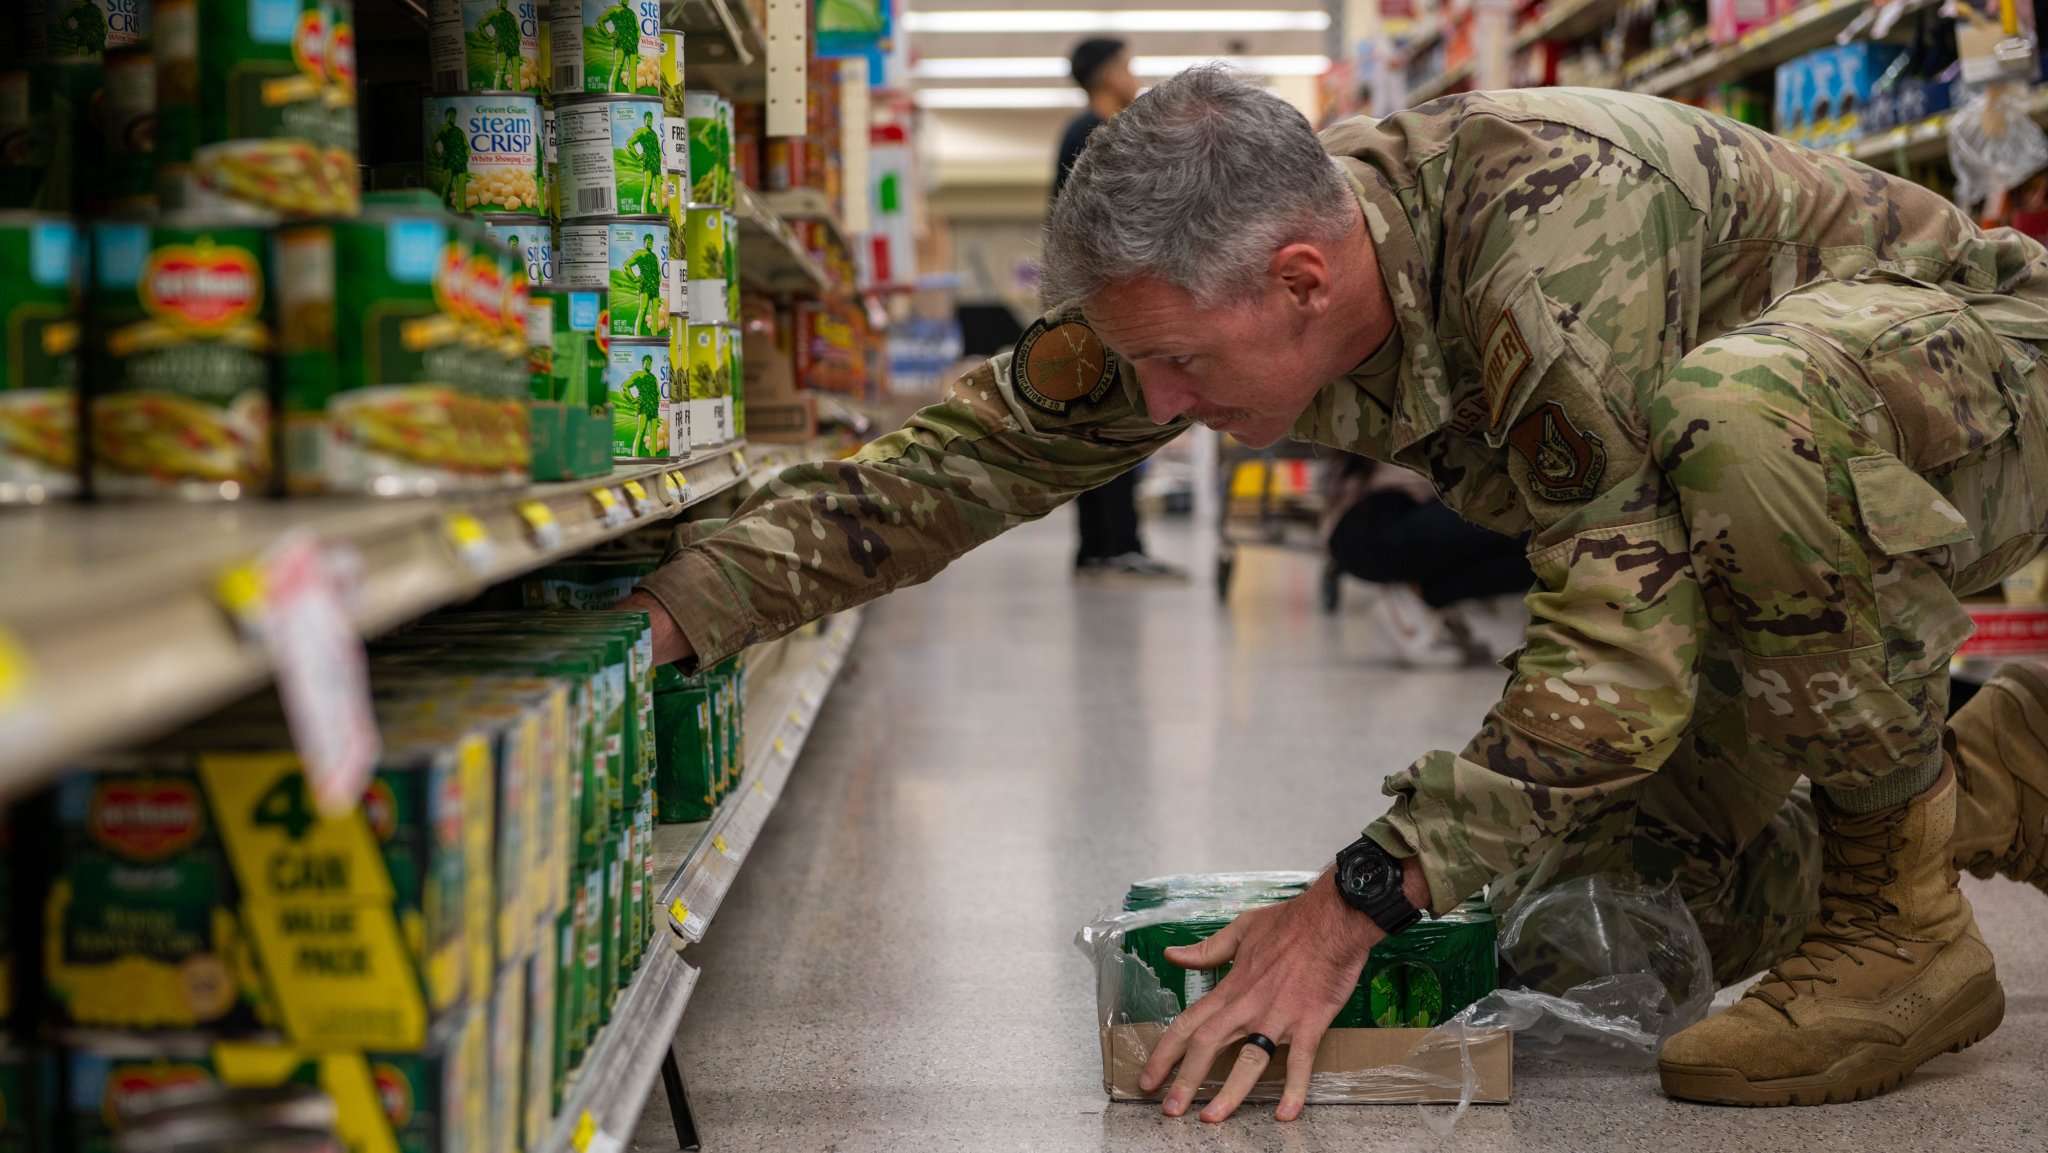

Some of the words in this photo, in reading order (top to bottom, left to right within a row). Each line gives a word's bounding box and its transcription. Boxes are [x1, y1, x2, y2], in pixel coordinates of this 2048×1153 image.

[475, 105, 506, 114] Green
[469, 115, 531, 134] steam
[470, 134, 531, 153] CRISP
[1017, 344, 1047, 406] COMMUNICATIONS
[575, 587, 620, 600] Green
[253, 773, 315, 839] 4
[272, 854, 348, 892] CAN
